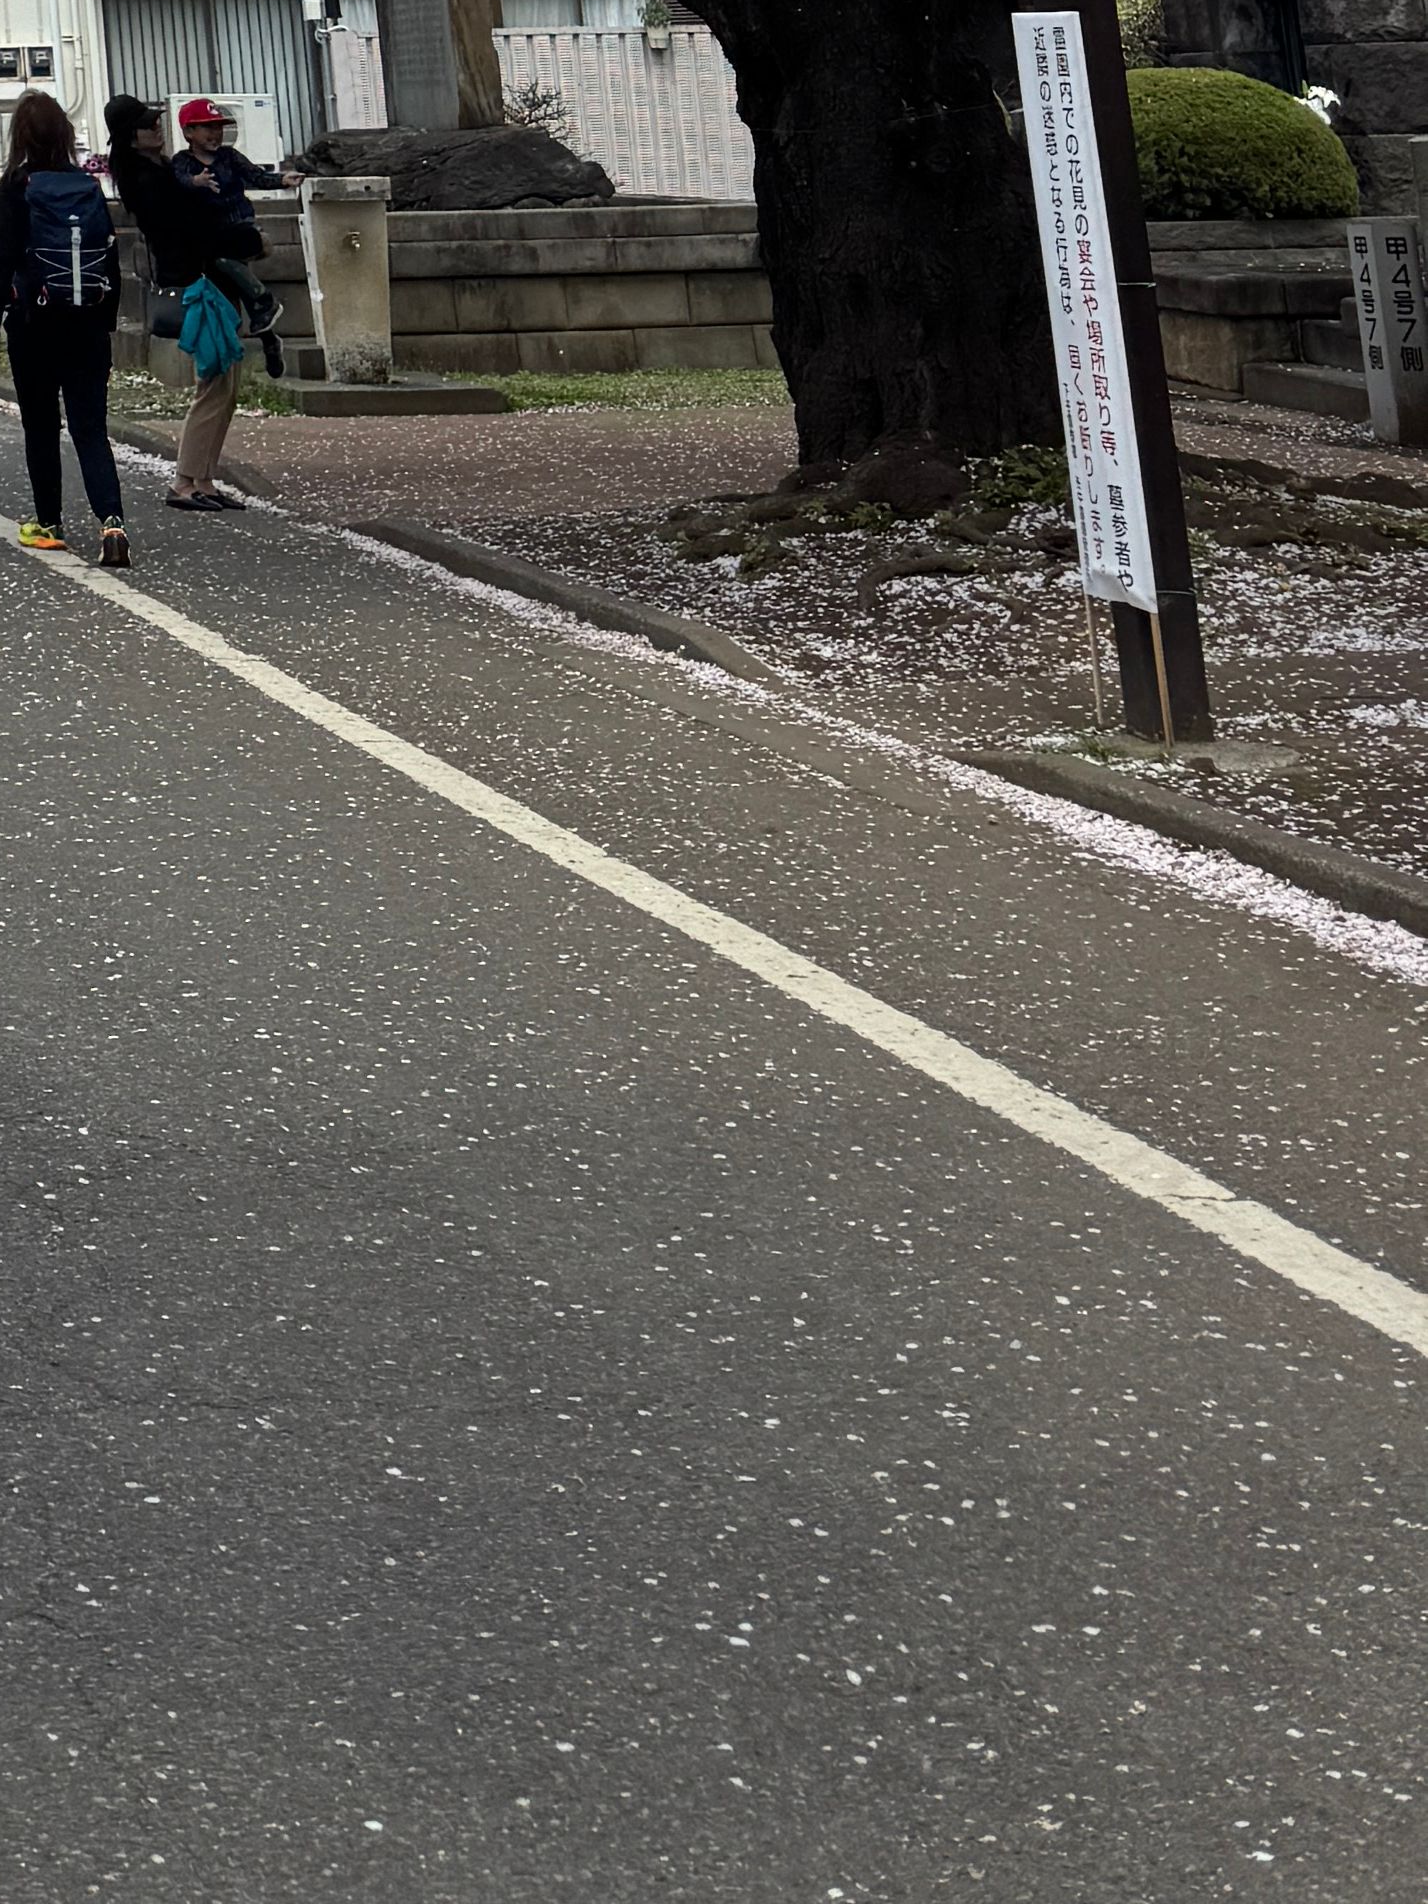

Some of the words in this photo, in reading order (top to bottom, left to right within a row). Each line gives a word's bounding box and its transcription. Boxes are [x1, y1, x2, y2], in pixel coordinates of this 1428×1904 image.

[1353, 235, 1385, 371] 甲4号7側
[1385, 236, 1425, 373] 甲4号7側
